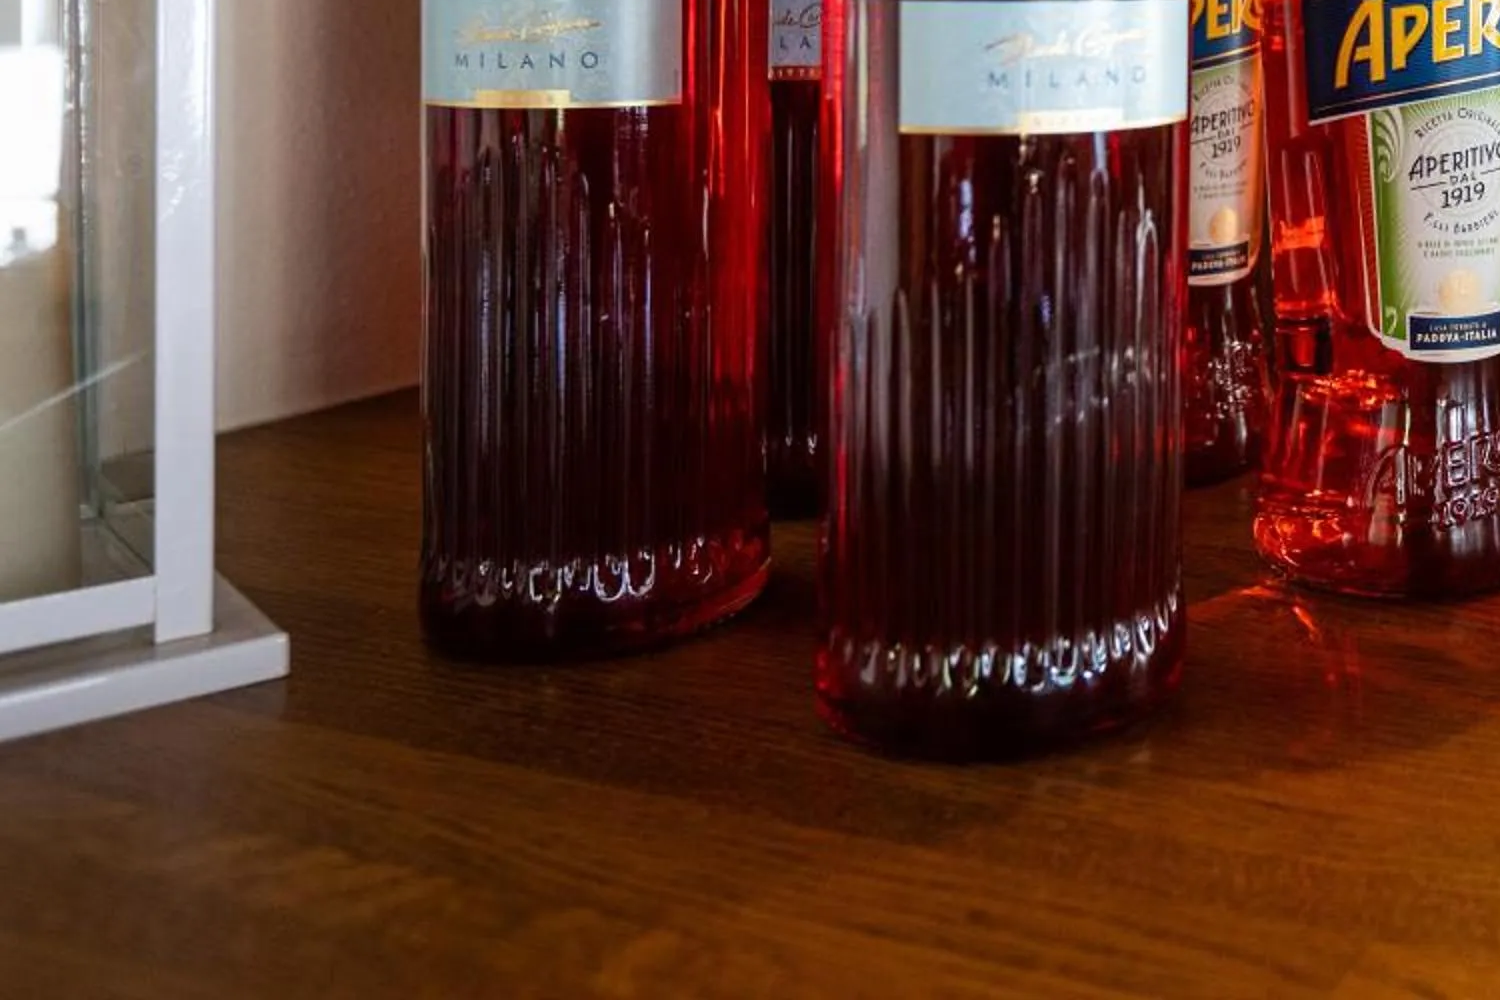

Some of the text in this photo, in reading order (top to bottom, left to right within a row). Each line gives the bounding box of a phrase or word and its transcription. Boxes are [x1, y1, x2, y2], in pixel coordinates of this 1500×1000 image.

[455, 51, 600, 70] MILANO
[988, 66, 1146, 89] MILANO
[1450, 171, 1477, 186] DAL
[1441, 182, 1485, 208] 1919
